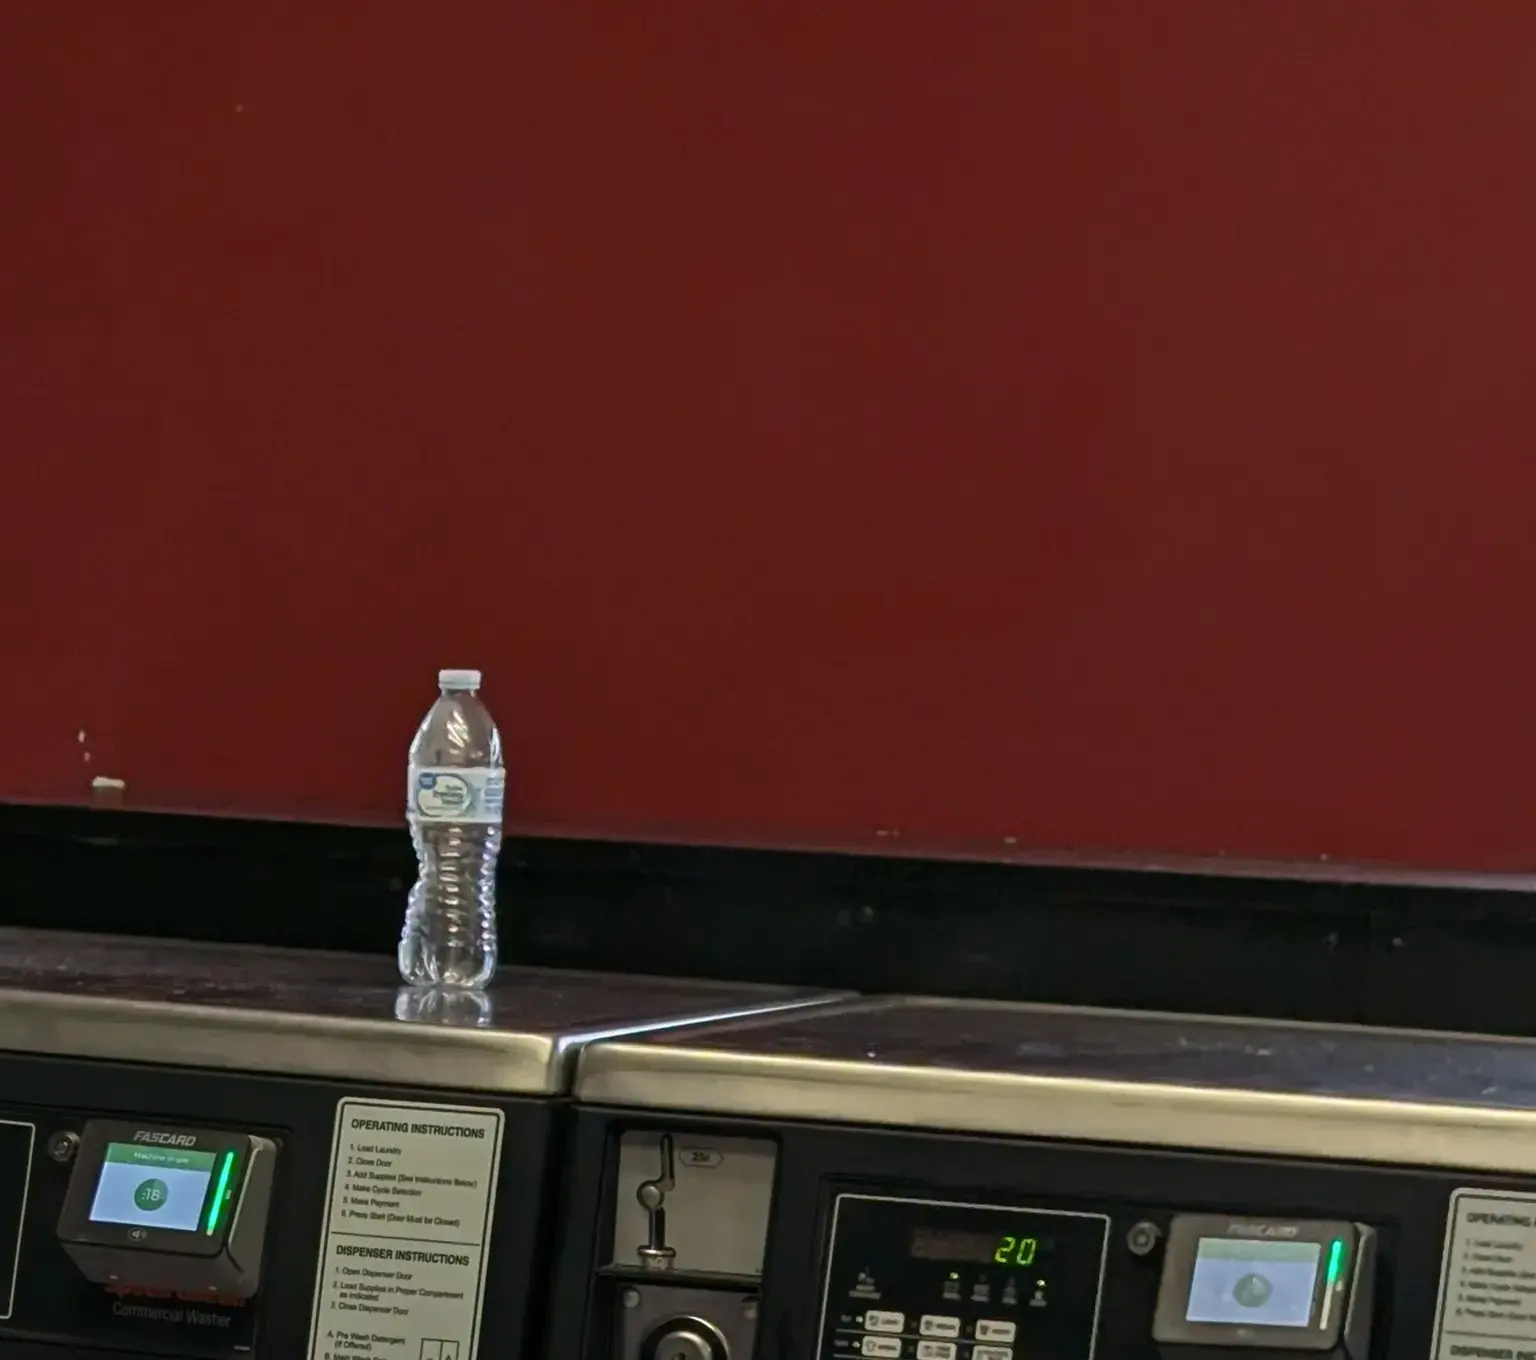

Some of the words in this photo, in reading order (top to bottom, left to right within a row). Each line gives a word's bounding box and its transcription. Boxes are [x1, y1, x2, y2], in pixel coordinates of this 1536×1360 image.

[351, 1118, 409, 1133] OPERATING
[411, 1123, 485, 1139] INSTRUCTIONS
[133, 1130, 197, 1147] FASCARD
[357, 1144, 374, 1153] Load
[375, 1145, 402, 1156] Laundry
[355, 1157, 375, 1166] Close
[376, 1158, 393, 1167] Door
[353, 1170, 367, 1179] Add
[368, 1172, 396, 1182] Supplies
[398, 1173, 414, 1183] (See
[352, 1183, 371, 1193] Make
[371, 1185, 391, 1195] Cycle
[391, 1186, 422, 1197] Selection
[350, 1197, 369, 1206] Make
[370, 1198, 400, 1209] Payment
[348, 1209, 368, 1219] Press
[369, 1210, 386, 1220] Start
[386, 1212, 405, 1222] (Door
[406, 1213, 422, 1223] Must
[423, 1214, 433, 1224] be
[433, 1216, 460, 1228] Closed)
[336, 1244, 393, 1260] DISPENSER
[395, 1249, 470, 1266] INSTRUCTIONS
[994, 1236, 1037, 1265] 20
[342, 1266, 360, 1277] Open
[362, 1268, 395, 1279] Dispenser
[396, 1271, 413, 1281] Door
[340, 1281, 357, 1290] Load
[358, 1282, 386, 1293] Supplies
[388, 1284, 394, 1293] in
[395, 1286, 417, 1297] Proper
[419, 1288, 464, 1299] Compartment
[113, 1301, 184, 1323] Commercial
[186, 1310, 232, 1328] Washer
[338, 1301, 357, 1311] Close
[358, 1303, 392, 1314] Dispenser
[393, 1306, 410, 1316] Door
[336, 1331, 349, 1340] Pre
[350, 1332, 370, 1341] Wash
[371, 1334, 406, 1345] Detergent
[343, 1342, 372, 1352] Offered)
[324, 1352, 332, 1360] B.
